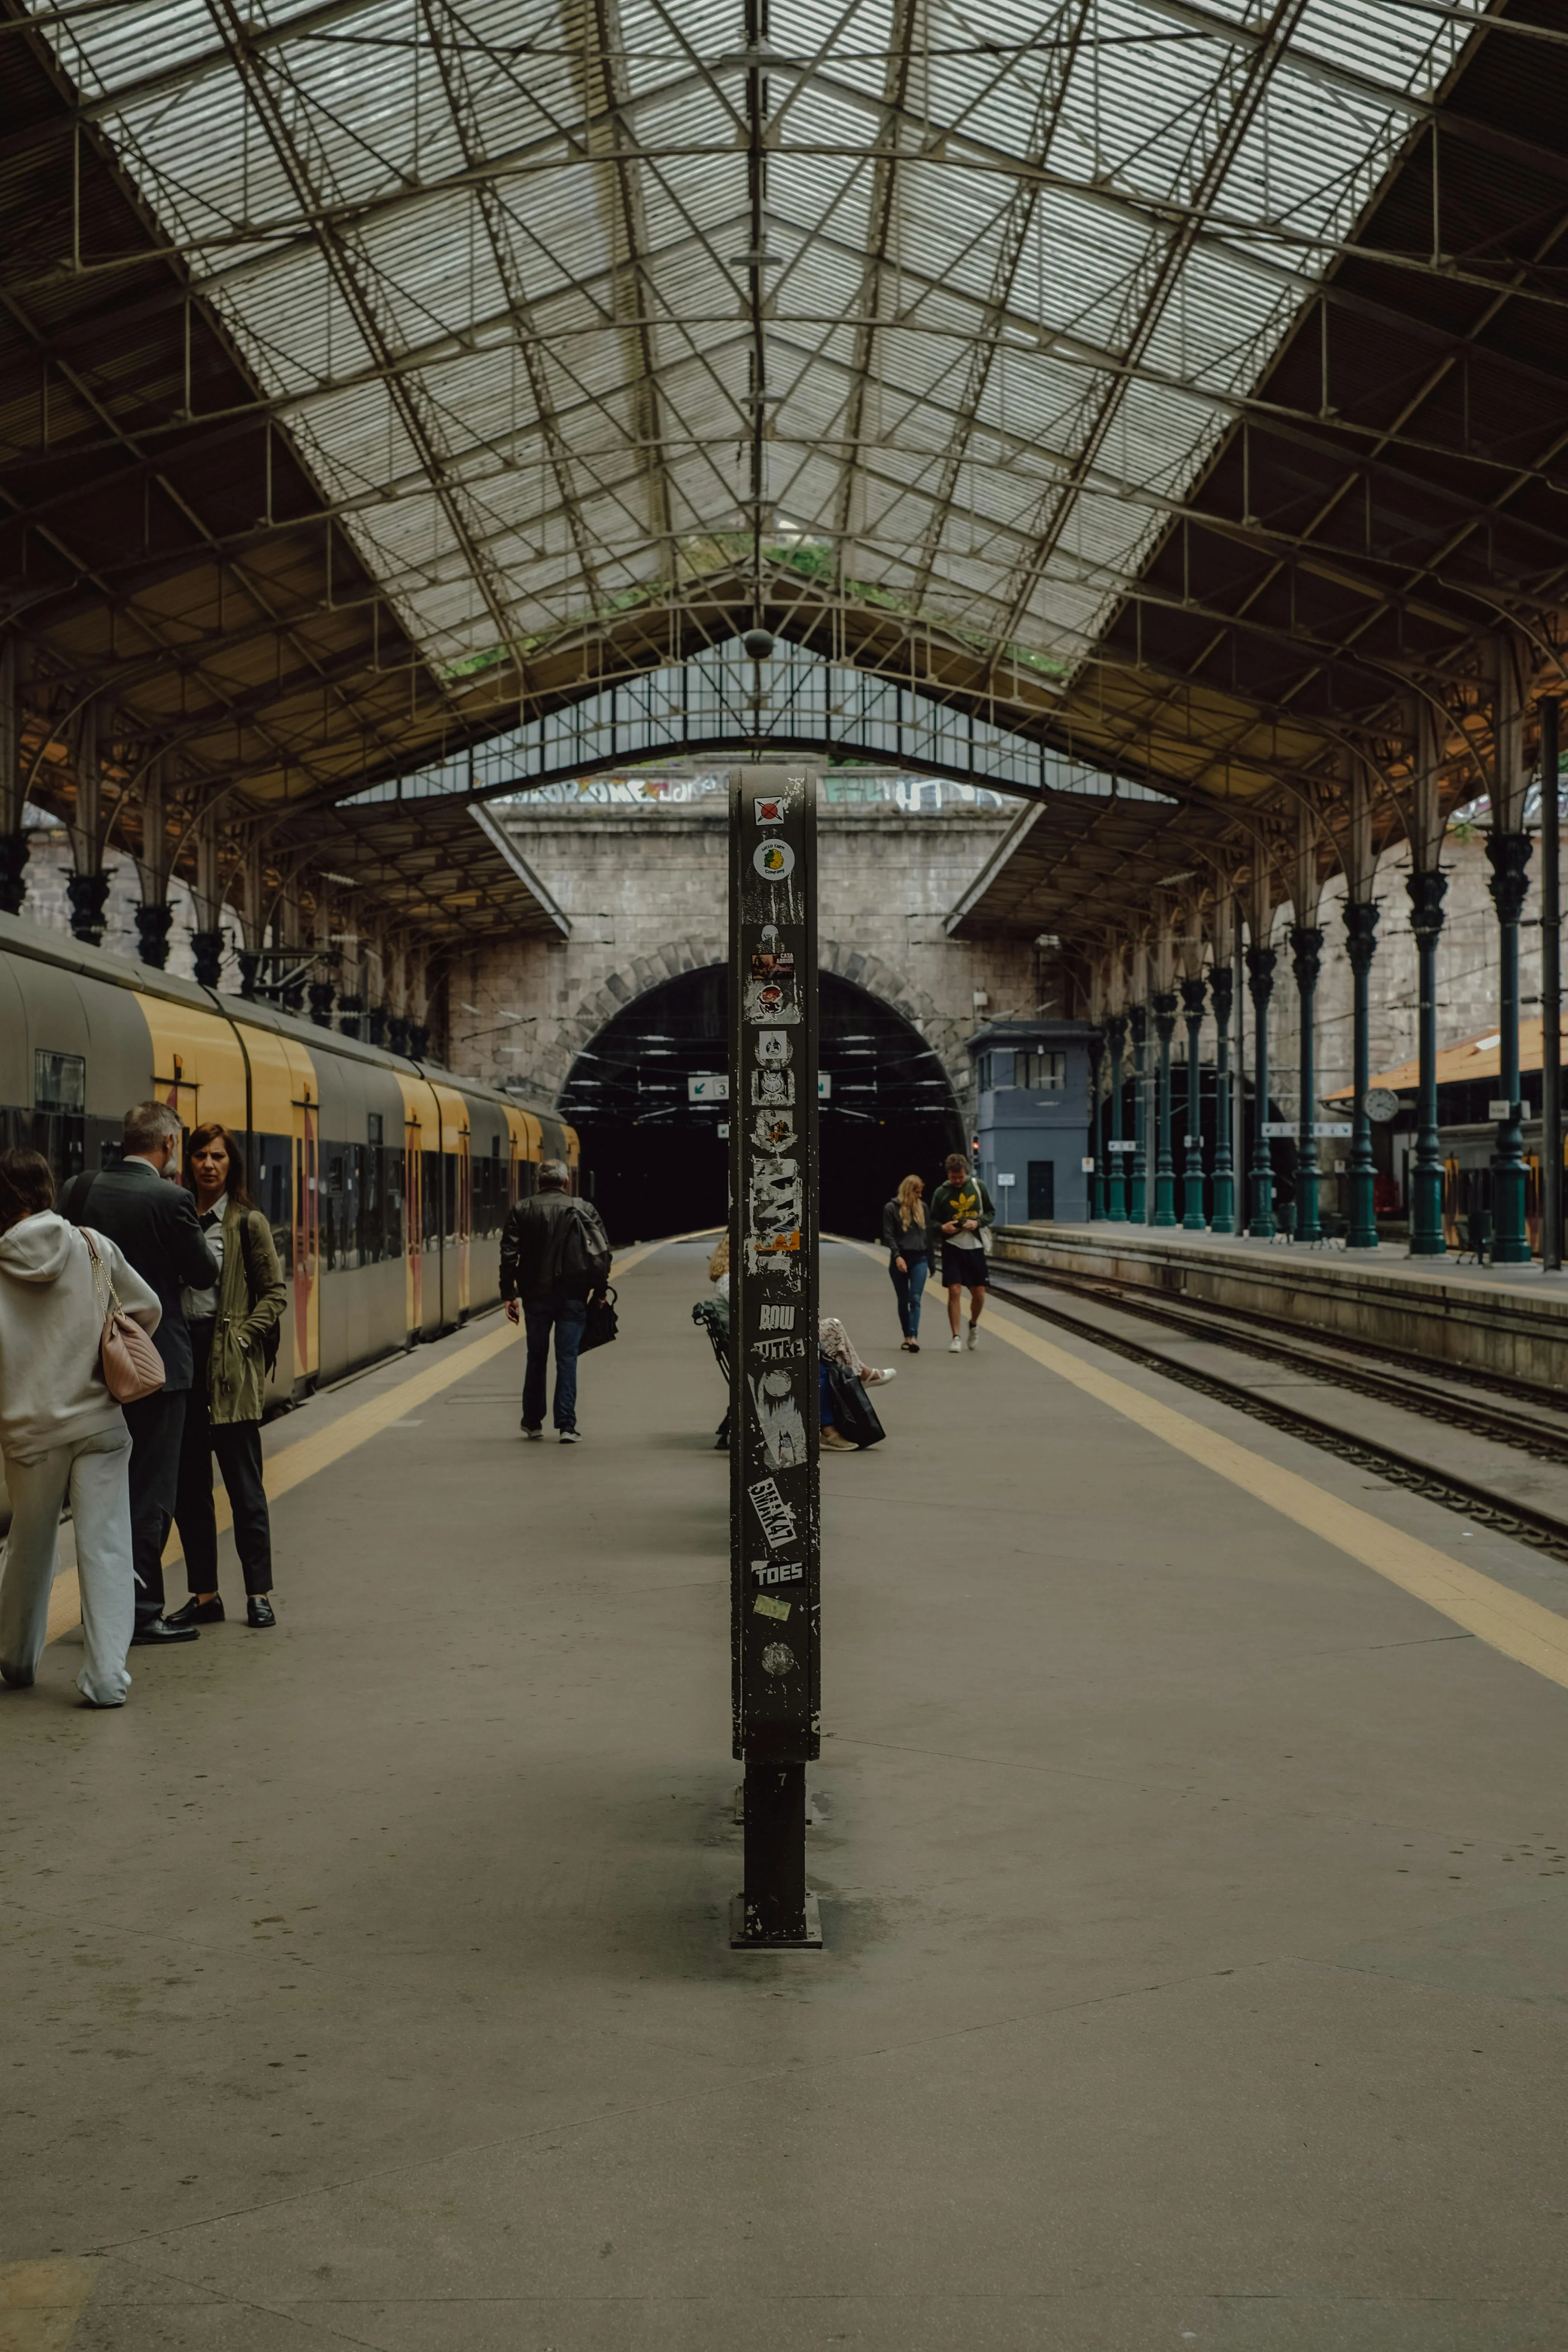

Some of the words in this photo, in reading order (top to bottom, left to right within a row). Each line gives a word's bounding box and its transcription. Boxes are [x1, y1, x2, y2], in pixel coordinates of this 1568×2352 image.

[719, 1084, 726, 1095] 3
[750, 1482, 793, 1542] SMAK47
[756, 1562, 802, 1585] TOES
[778, 1773, 787, 1786] 7
